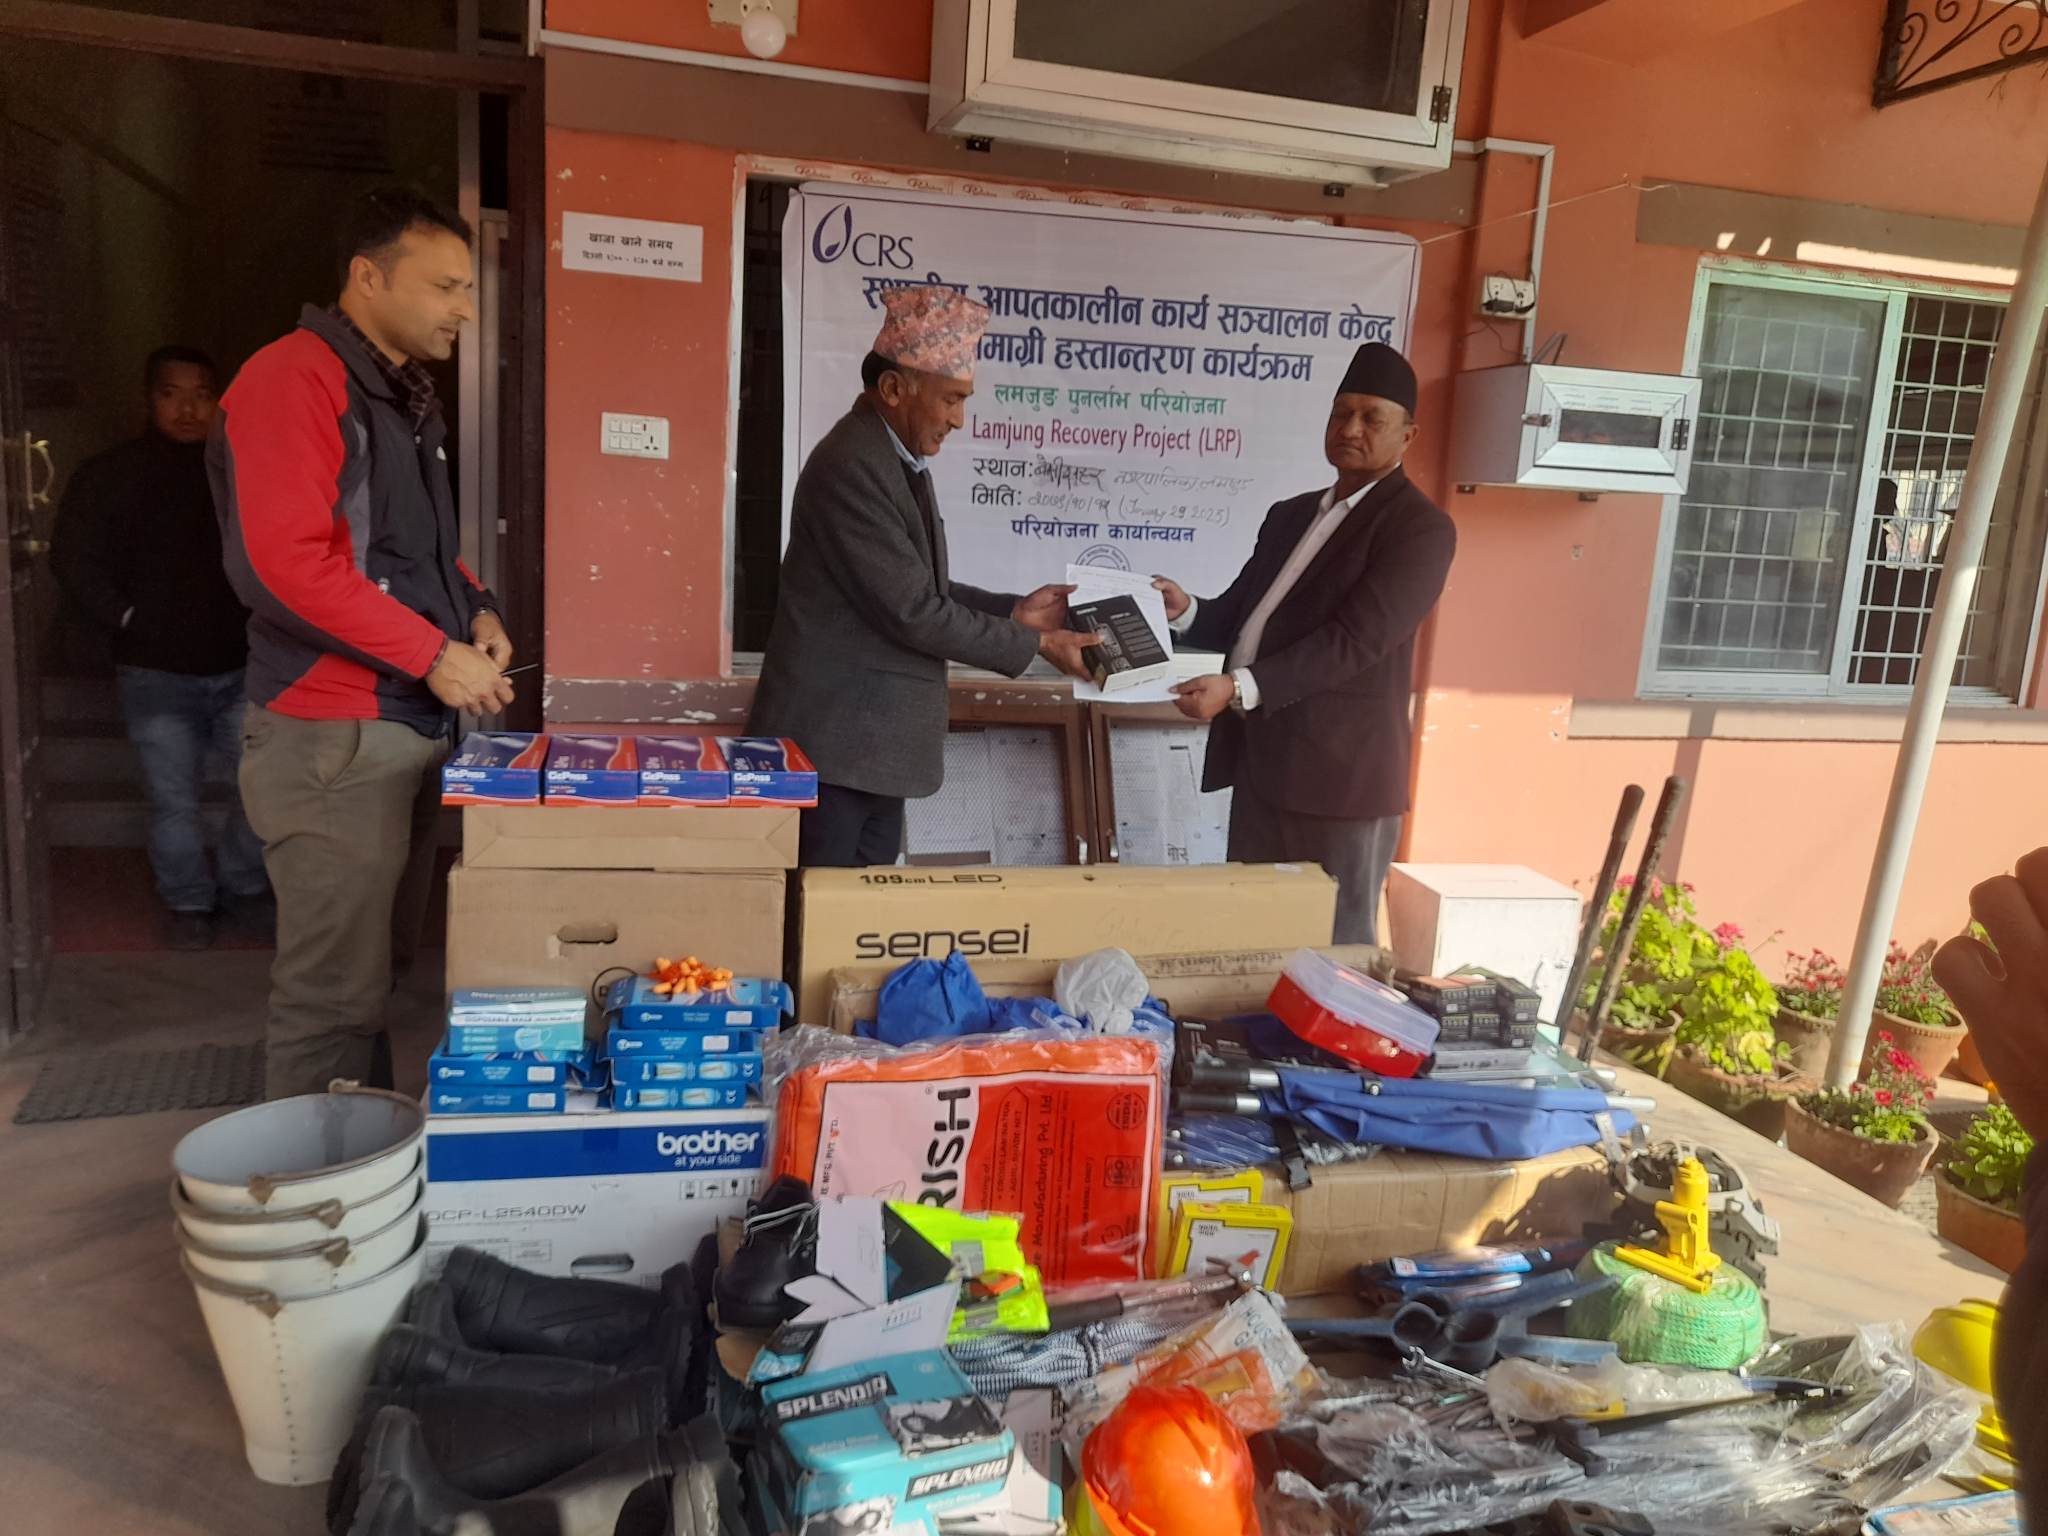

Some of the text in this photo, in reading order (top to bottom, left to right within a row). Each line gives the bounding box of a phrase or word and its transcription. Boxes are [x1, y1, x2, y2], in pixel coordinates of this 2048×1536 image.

[589, 232, 674, 250] खाजा खाने समय
[852, 232, 915, 270] CRS
[977, 285, 1144, 325] आपतकालीन
[1152, 294, 1210, 331] कार्य
[1054, 335, 1196, 375] हस्तान्तरण
[1203, 342, 1314, 382] कार्यक्रम
[994, 384, 1059, 413] लमजुङ
[1140, 387, 1228, 416] परियोजना
[972, 414, 1242, 459] Lamjung Recovery Project (LRP)
[972, 456, 1033, 479] स्थान:
[971, 482, 1022, 507] मिति:
[1010, 515, 1197, 543] परियोजना कार्यान्वयन
[928, 874, 1002, 884] LED
[855, 922, 1031, 960] sensei
[657, 1129, 760, 1157] brother
[674, 1152, 742, 1170] at your side
[1031, 1146, 1054, 1246] Manufacturing
[777, 1374, 889, 1420] SPLENDID
